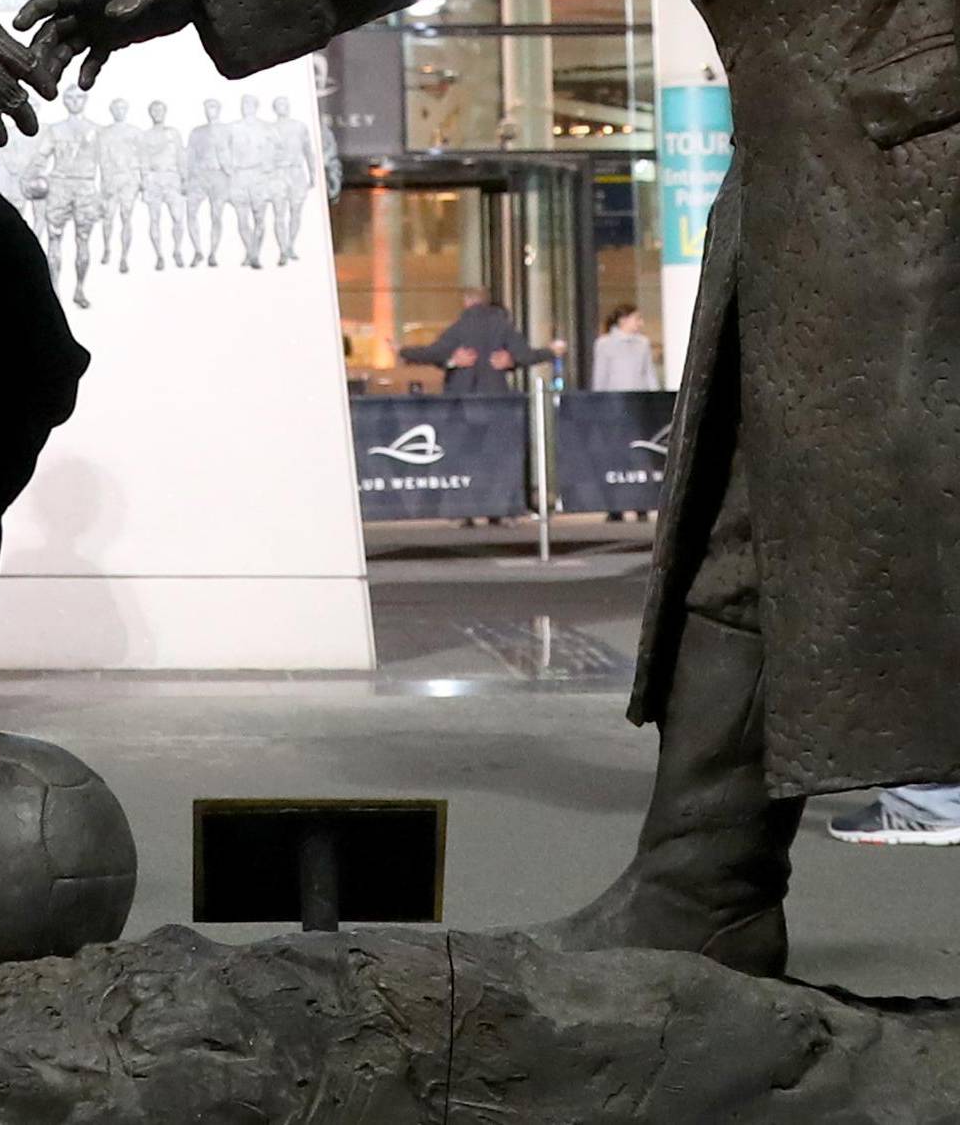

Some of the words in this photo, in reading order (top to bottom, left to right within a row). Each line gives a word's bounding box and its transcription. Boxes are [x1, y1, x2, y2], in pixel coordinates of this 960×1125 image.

[664, 131, 731, 155] TOUR
[390, 474, 472, 490] WEMBLEY
[605, 470, 648, 484] CLUB
